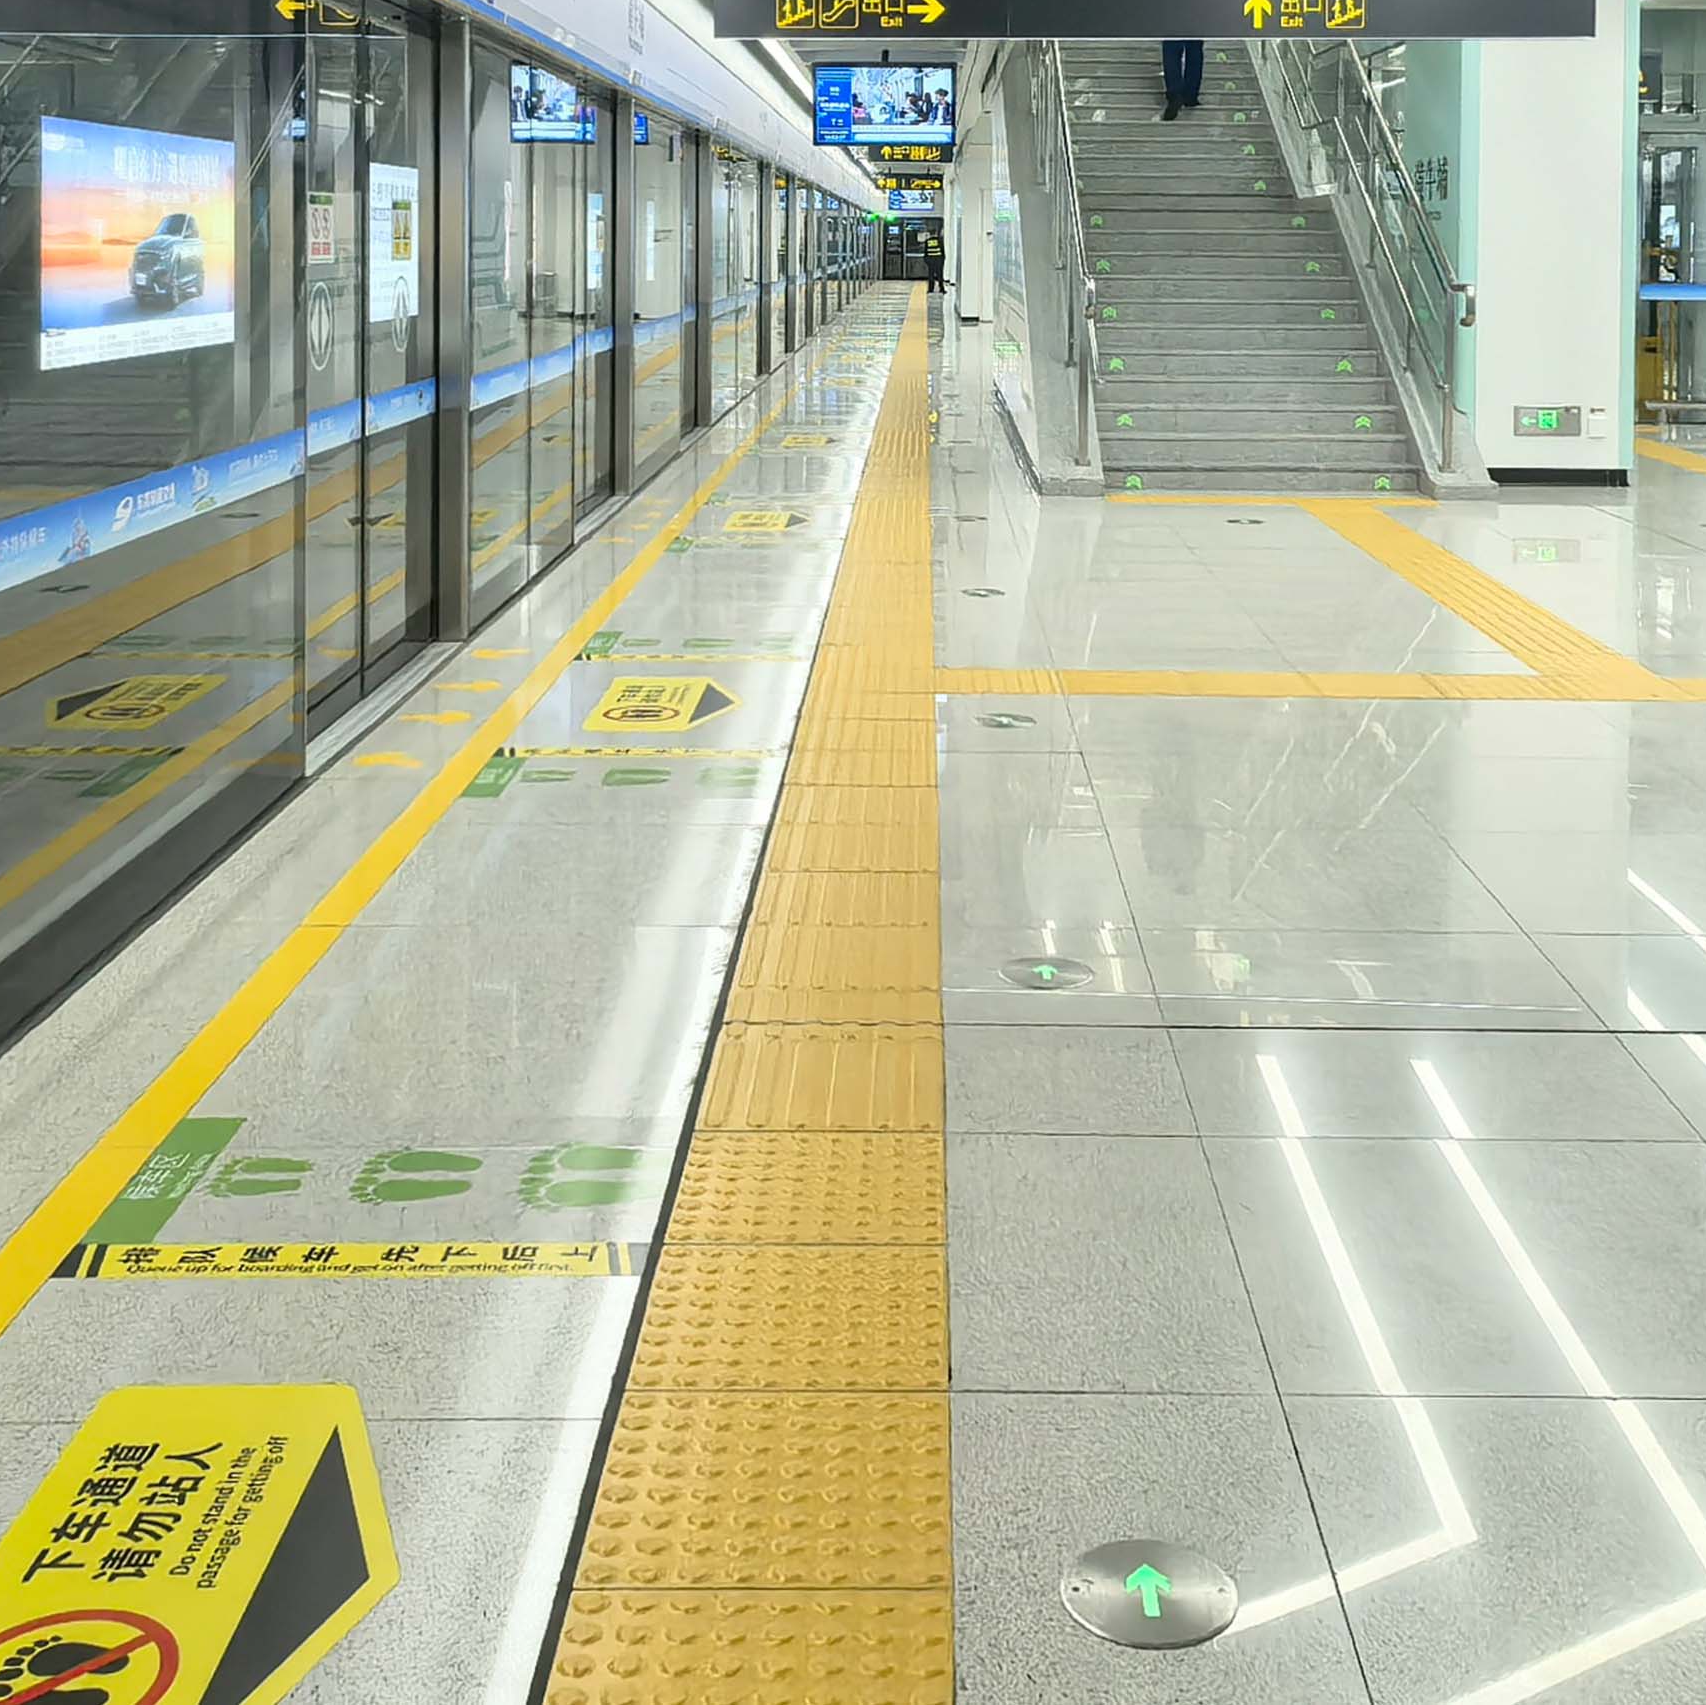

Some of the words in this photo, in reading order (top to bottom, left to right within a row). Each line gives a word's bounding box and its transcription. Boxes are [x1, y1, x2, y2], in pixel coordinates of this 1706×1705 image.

[880, 16, 903, 28] Exit
[1280, 16, 1304, 28] Exit
[233, 1446, 258, 1469] the
[267, 1435, 289, 1464] off
[225, 1464, 243, 1485] in
[240, 1457, 280, 1504] getting
[22, 1443, 160, 1584] 下车通道
[91, 1443, 224, 1583] 请勿站人
[201, 1484, 235, 1526] stand
[229, 1503, 253, 1528] for
[188, 1525, 213, 1554] not
[168, 1553, 196, 1576] Do
[196, 1526, 243, 1590] passage
